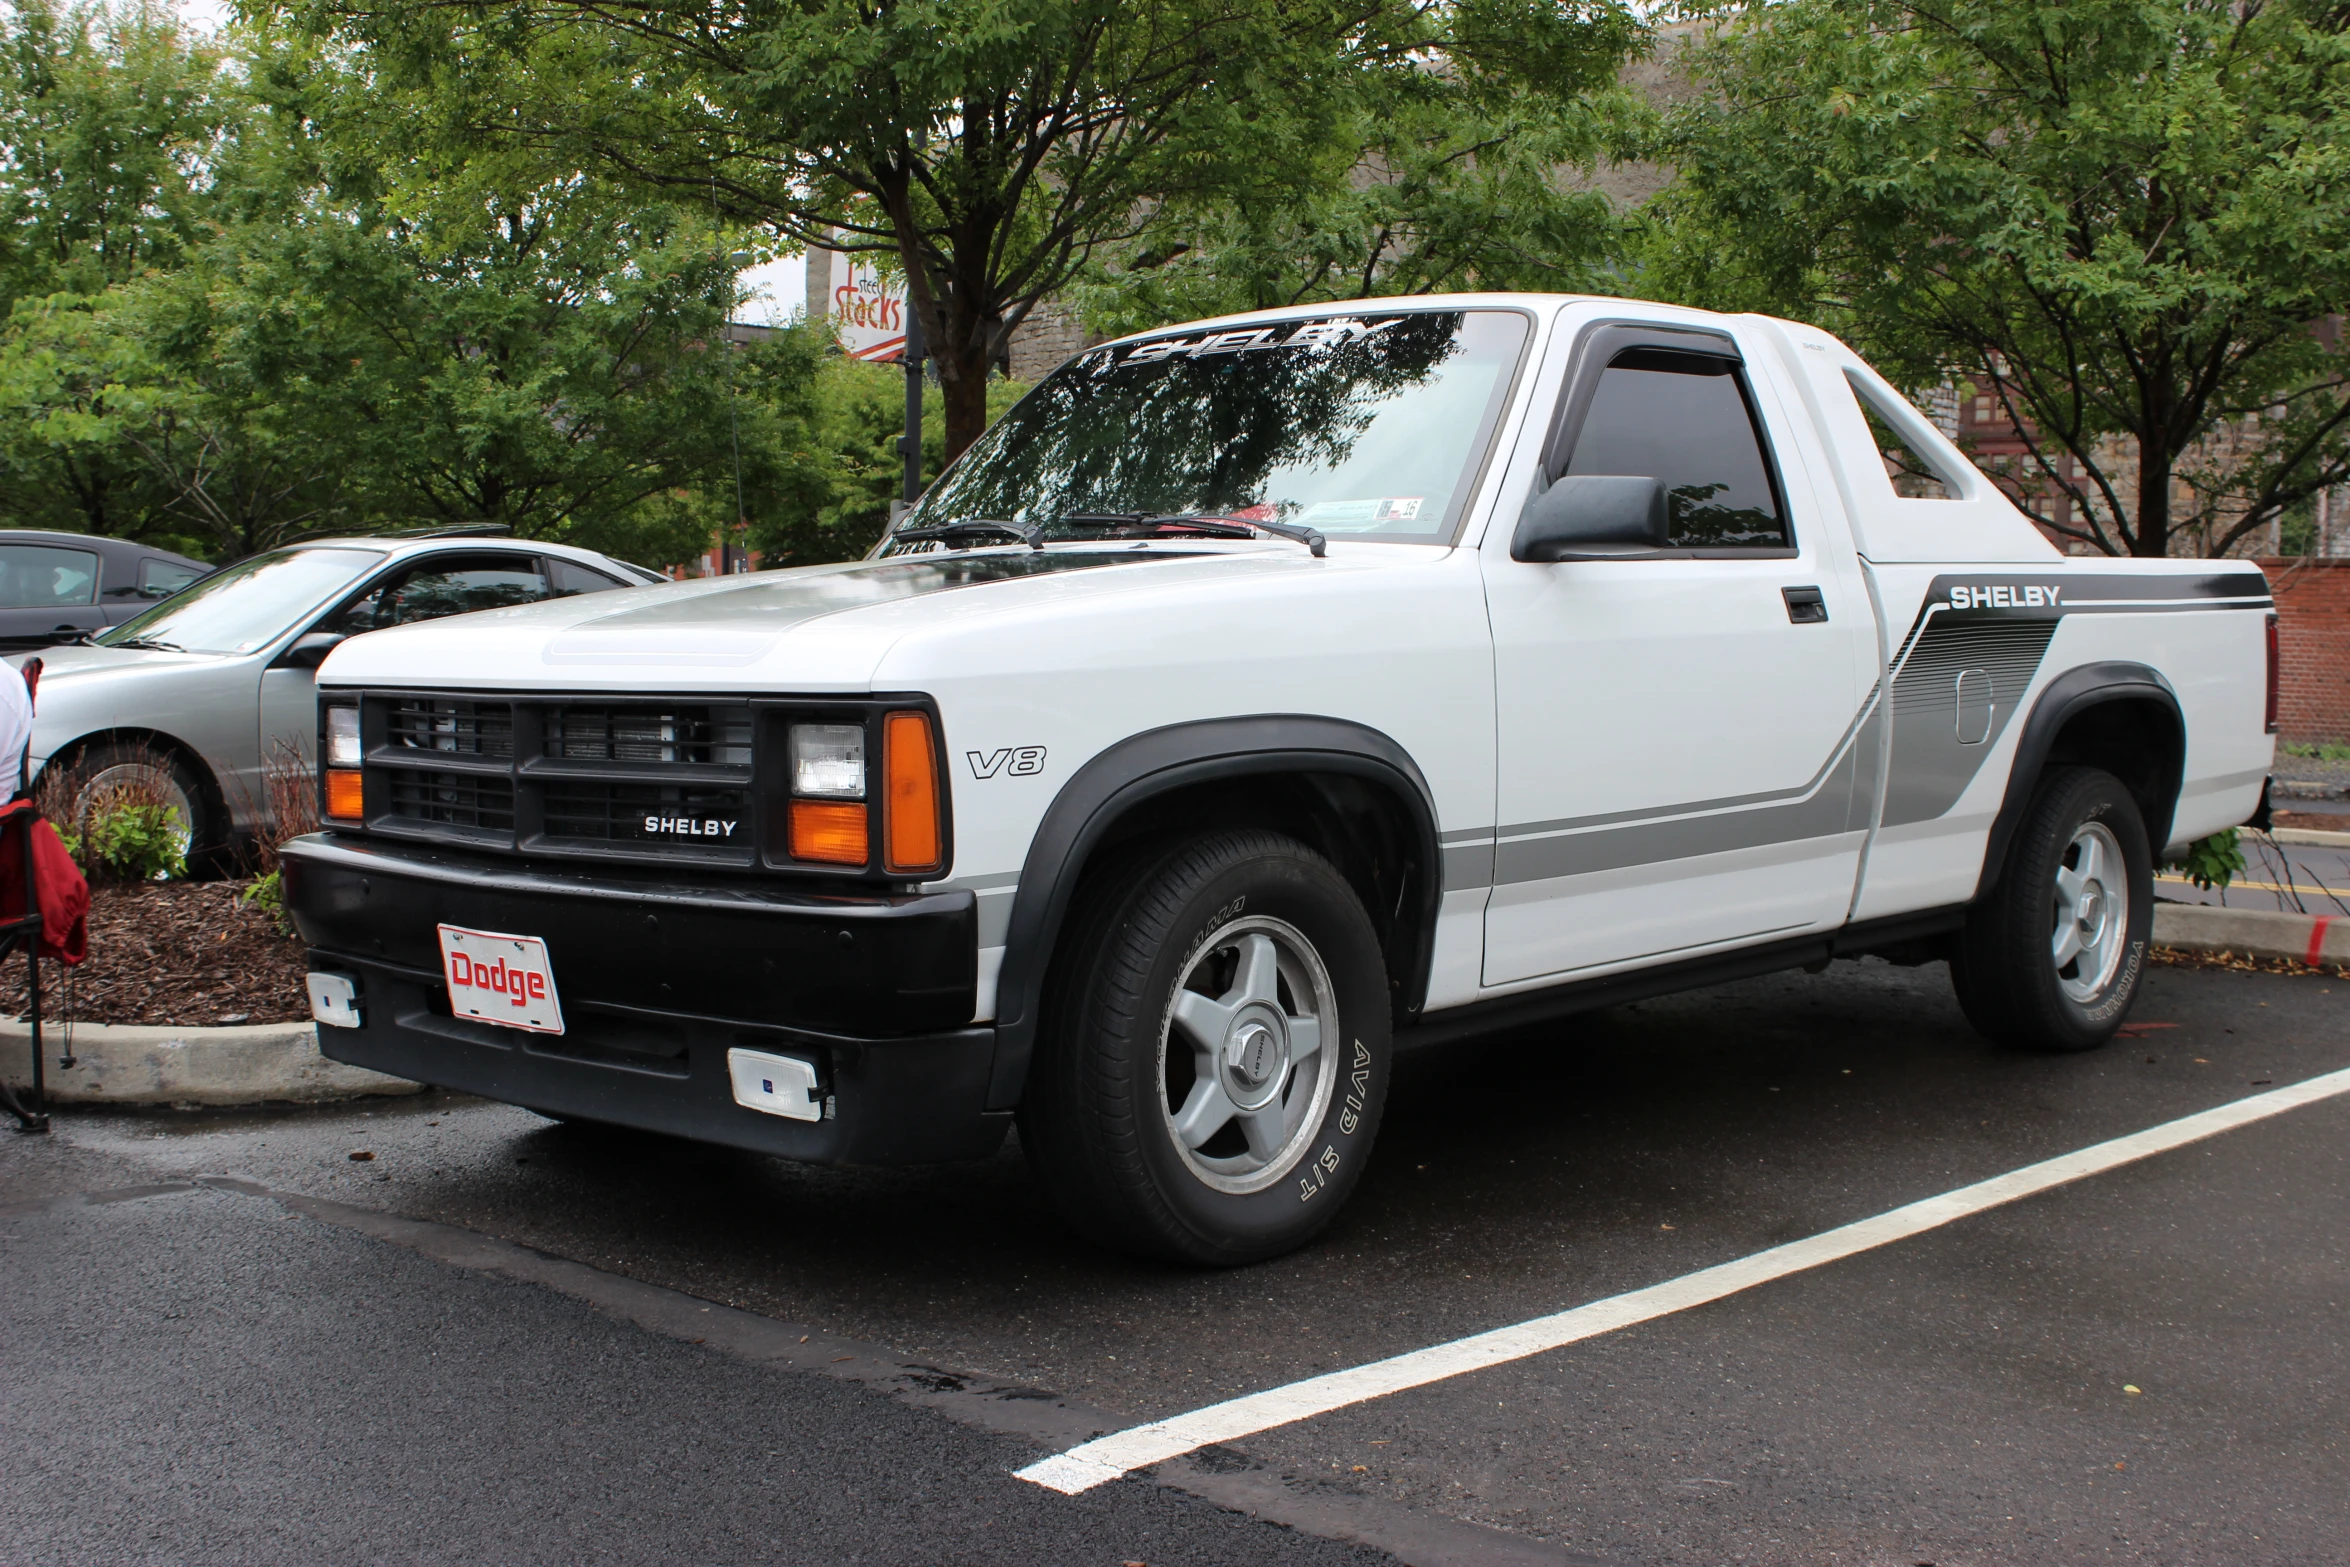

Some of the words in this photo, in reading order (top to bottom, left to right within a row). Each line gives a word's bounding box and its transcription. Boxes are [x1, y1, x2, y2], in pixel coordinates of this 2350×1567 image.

[1117, 319, 1406, 368] SHELBY
[1402, 500, 1418, 516] 16
[1950, 586, 2060, 609] SHELBY
[966, 745, 1047, 780] V8
[645, 816, 737, 836] SHELBY
[451, 951, 546, 1007] Dodge
[2083, 941, 2144, 1021] YOKOHAMA
[1254, 1034, 1265, 1077] SHELBY
[1339, 1038, 1370, 1135] AVID
[1299, 1145, 1339, 1202] S/T
